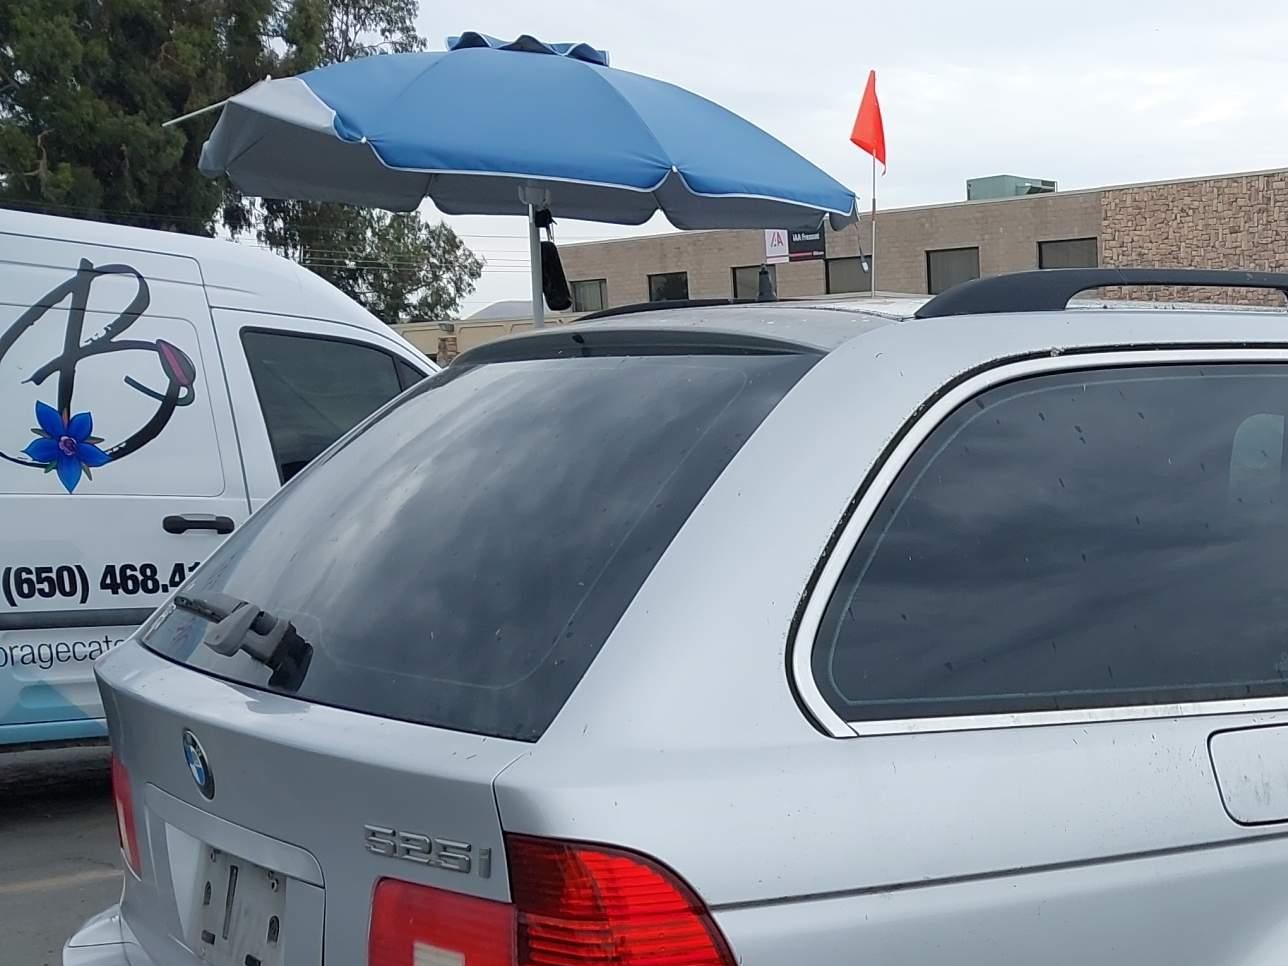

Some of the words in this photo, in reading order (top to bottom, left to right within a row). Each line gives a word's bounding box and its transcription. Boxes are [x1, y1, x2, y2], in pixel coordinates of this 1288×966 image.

[2, 565, 90, 607] (650)
[100, 561, 201, 595] 468.4
[0, 635, 126, 670] oragecat
[363, 823, 492, 879] 525i
